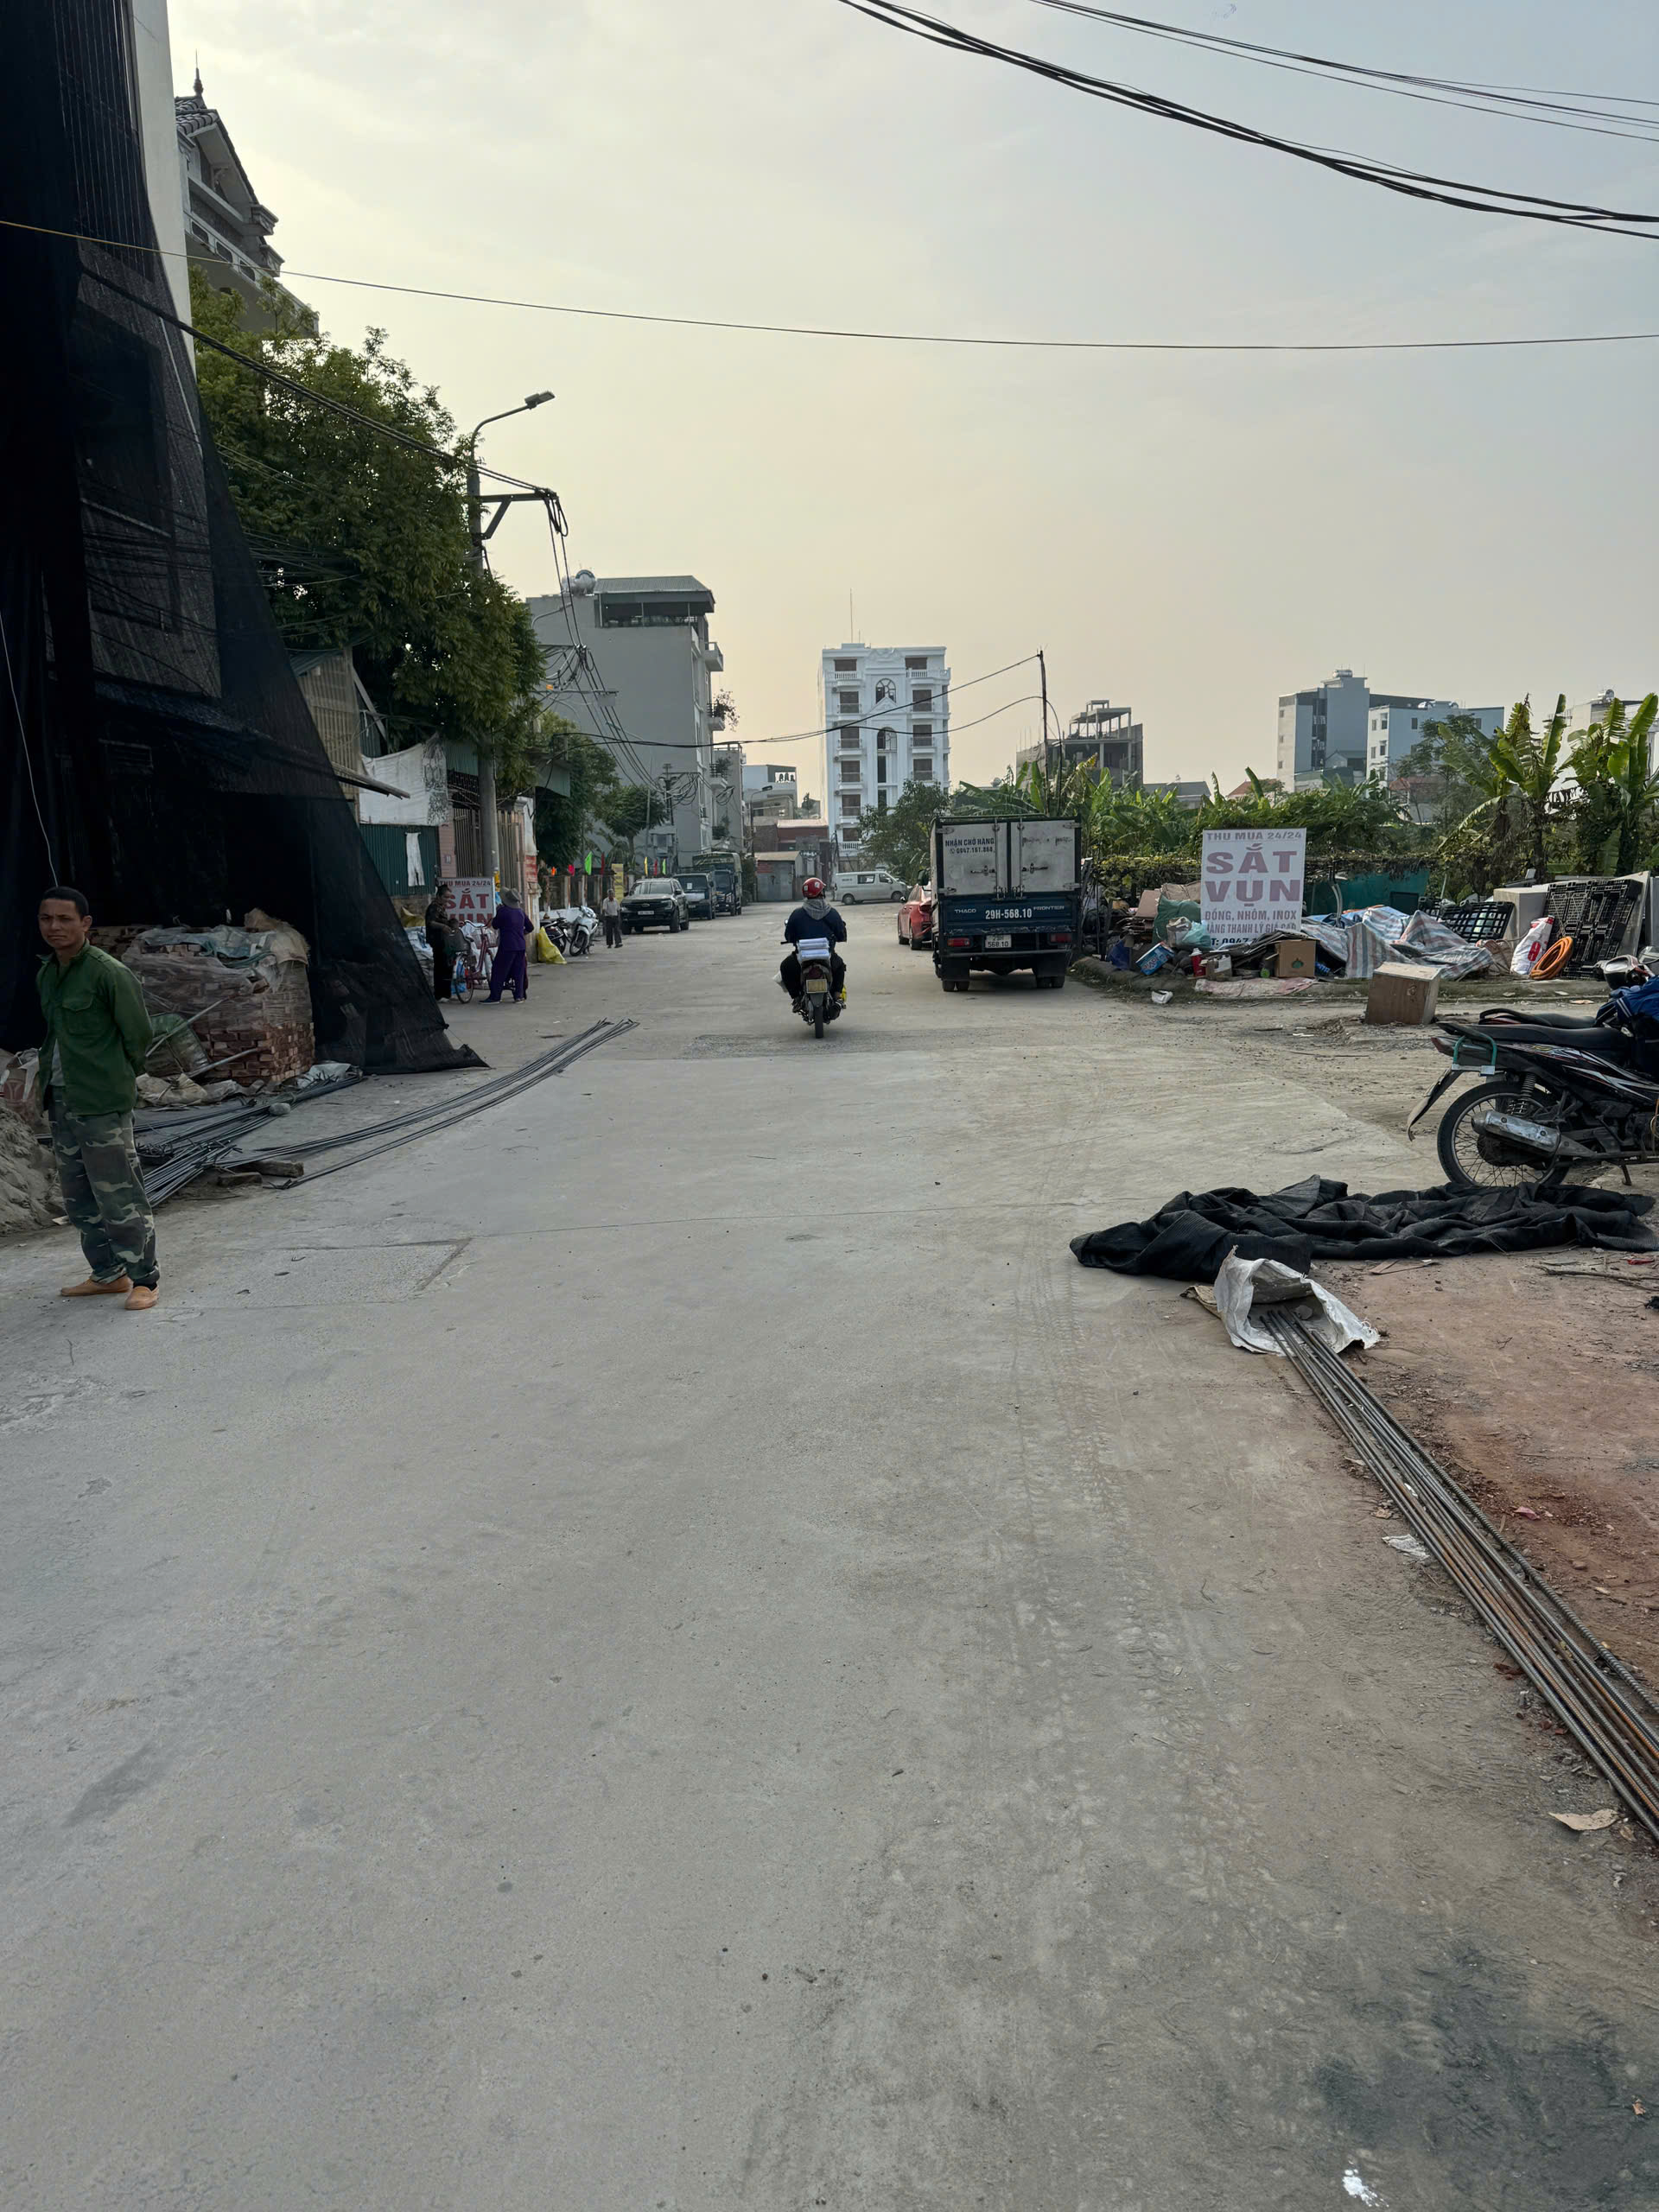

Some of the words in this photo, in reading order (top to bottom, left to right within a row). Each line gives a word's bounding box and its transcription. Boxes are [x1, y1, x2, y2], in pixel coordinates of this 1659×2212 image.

[1206, 832, 1230, 841] THU
[1267, 831, 1302, 840] 24/24
[1205, 842, 1298, 874] SẮT
[446, 888, 489, 909] SẮT
[1205, 879, 1301, 907] VỤN
[985, 908, 1033, 920] 29H-568.10
[1273, 910, 1297, 920] INOX
[1227, 923, 1253, 933] THANH
